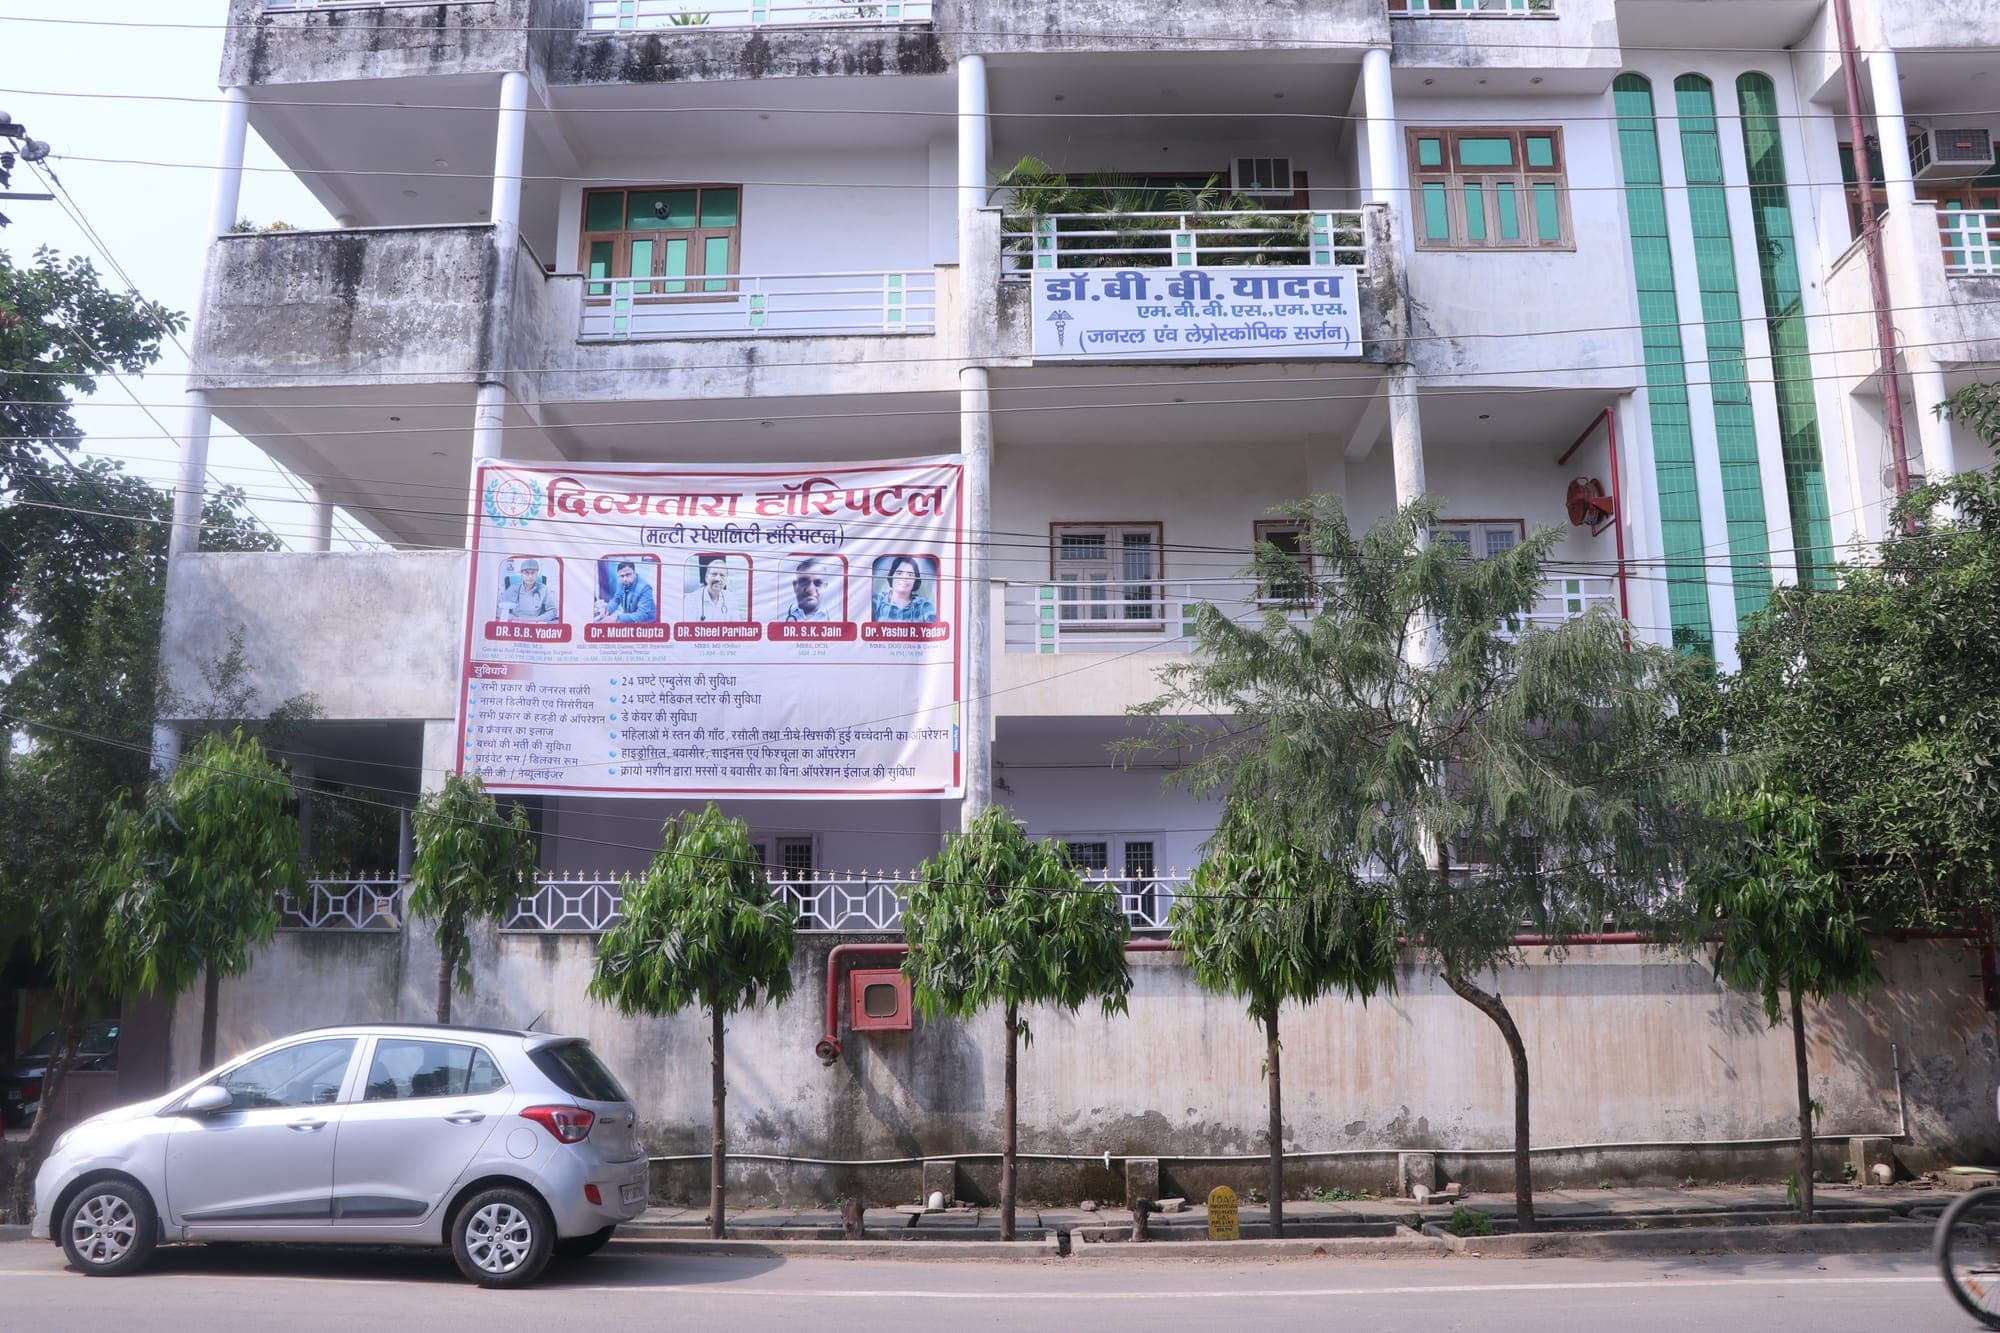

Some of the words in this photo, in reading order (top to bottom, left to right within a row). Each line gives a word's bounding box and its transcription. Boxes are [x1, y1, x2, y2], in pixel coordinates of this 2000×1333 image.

[1079, 328, 1145, 354] (जनरल
[1185, 322, 1288, 343] लेप्रोस्कोपिक
[1293, 321, 1351, 350] सर्जन)
[546, 477, 743, 518] दिव्यतारा
[755, 477, 948, 518] हॉस्पिटल
[641, 522, 684, 548] (मल्टी
[689, 523, 760, 545] स्पेशलिटी
[766, 523, 844, 549] हॉस्पिटल)
[495, 625, 512, 637] DR.
[514, 626, 533, 638] B.B.
[535, 627, 563, 639] Yadav
[607, 627, 634, 638] Mudit
[636, 627, 664, 639] Gupta
[677, 626, 693, 638] DR.
[694, 626, 720, 638] Sheel
[722, 626, 759, 638] Parihar
[783, 626, 799, 638] DR.
[801, 626, 819, 638] S.K.
[821, 626, 842, 638] Jain
[881, 627, 908, 638] Yashu
[910, 627, 919, 638] R.
[920, 627, 947, 638] Yadav
[481, 681, 498, 692] सभी
[500, 684, 522, 693] प्रकार
[525, 682, 536, 694] की
[539, 686, 566, 695] जनरल
[621, 676, 634, 687] 24
[637, 674, 656, 687] घण्टे
[659, 673, 691, 690] एम्बुलेंस
[694, 673, 705, 687] की
[708, 673, 736, 690] सुविधा
[506, 696, 539, 708] डिलीवरी
[621, 694, 634, 705] 24
[637, 692, 656, 705] घण्टे
[695, 691, 716, 705] स्टोर
[719, 690, 731, 705] की
[733, 691, 761, 708] सुविधा
[479, 709, 496, 720] सभी
[498, 712, 521, 721] प्रकार
[621, 709, 629, 722] डे
[632, 709, 652, 722] केयर
[655, 709, 667, 722] की
[669, 709, 697, 726] सुविधा
[515, 727, 527, 735] का
[529, 728, 554, 737] इलाज
[621, 727, 659, 741] महिलाओं
[662, 727, 670, 740] में
[672, 730, 690, 740] स्तन
[693, 727, 705, 740] की
[761, 730, 780, 741] तथा
[783, 727, 801, 740] नीचे
[803, 727, 835, 741] खिसकी
[838, 727, 851, 745] हुई
[854, 727, 893, 741] बच्चेदानी
[896, 730, 908, 741] का
[500, 738, 511, 749] की
[532, 739, 543, 750] की
[546, 740, 572, 754] सुविधा
[712, 747, 743, 760] साइनस
[746, 747, 760, 760] एवं
[762, 745, 799, 762] फिश्चूला
[801, 748, 813, 759] का
[816, 746, 856, 759] ऑपरेशन
[505, 755, 521, 764] रूम
[529, 753, 561, 765] डिलक्स
[563, 757, 579, 767] रूम
[620, 763, 643, 777] क्रायो
[645, 763, 671, 777] मशीन
[673, 766, 692, 777] द्वारा
[695, 764, 718, 777] मस्सों
[721, 766, 727, 777] व
[729, 763, 762, 777] बवासीर
[765, 766, 777, 777] का
[780, 763, 798, 777] बिना
[801, 764, 840, 777] ऑपरेशन
[843, 763, 870, 779] ईलाज
[872, 764, 885, 777] की
[887, 764, 916, 781] सुविधा
